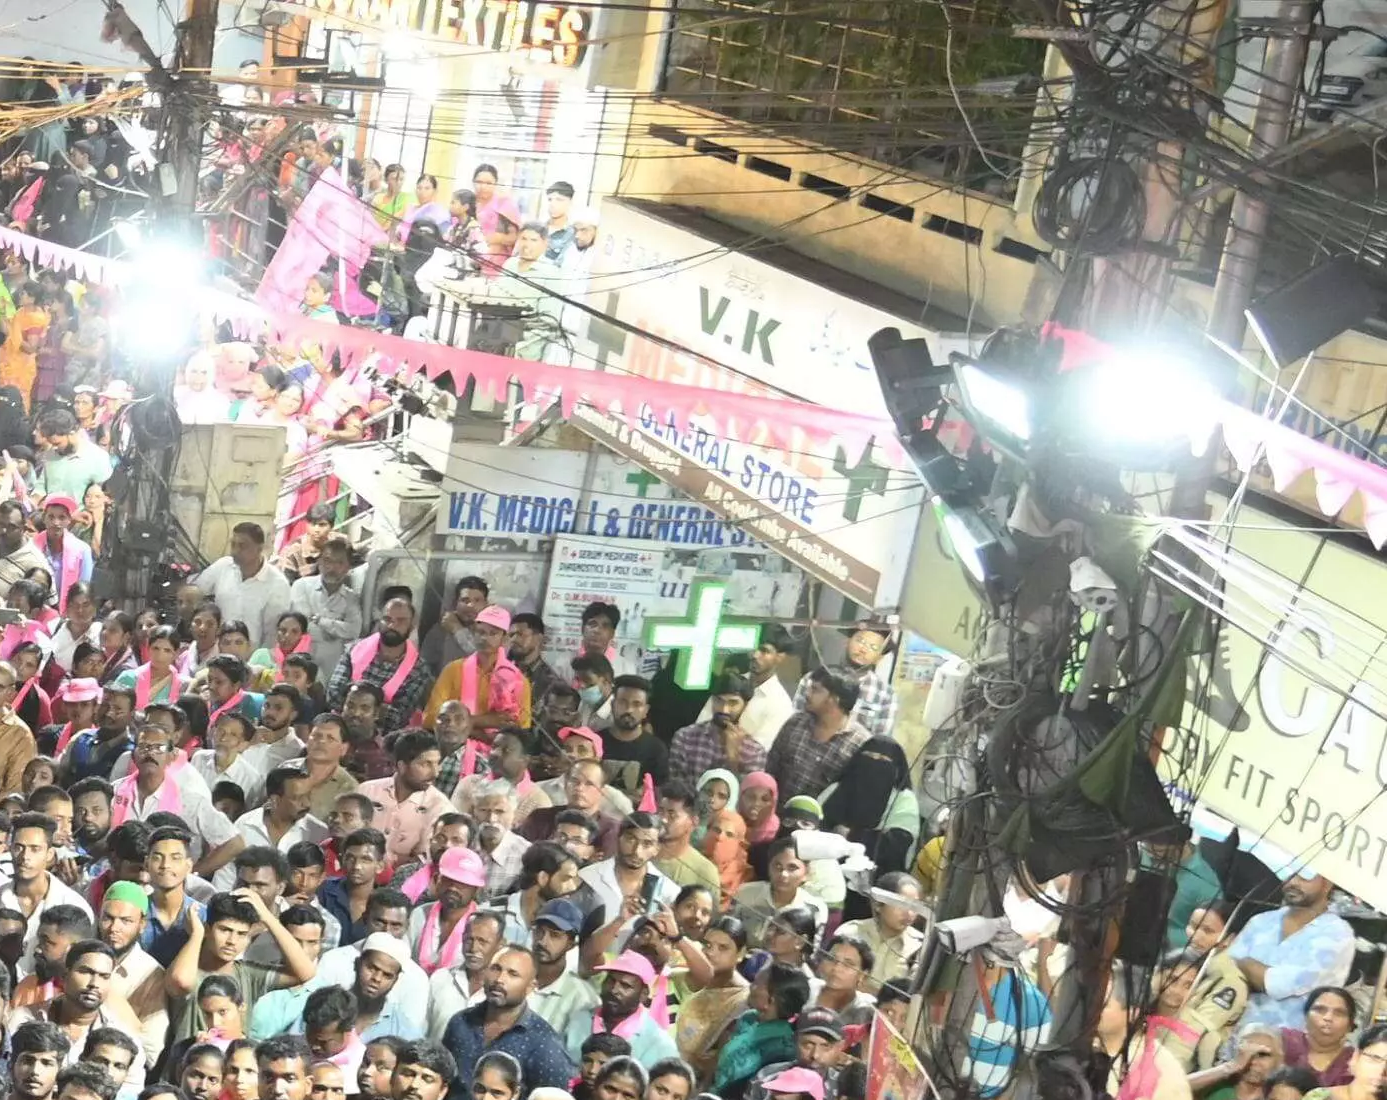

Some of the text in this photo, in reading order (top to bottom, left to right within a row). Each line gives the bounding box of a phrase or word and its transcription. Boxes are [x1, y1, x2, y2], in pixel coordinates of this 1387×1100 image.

[699, 286, 782, 367] V.K
[448, 491, 488, 531] V.K.
[495, 494, 597, 537] MEDICL
[603, 508, 621, 535] &
[740, 444, 819, 526] STORE
[1224, 754, 1275, 809] FIT
